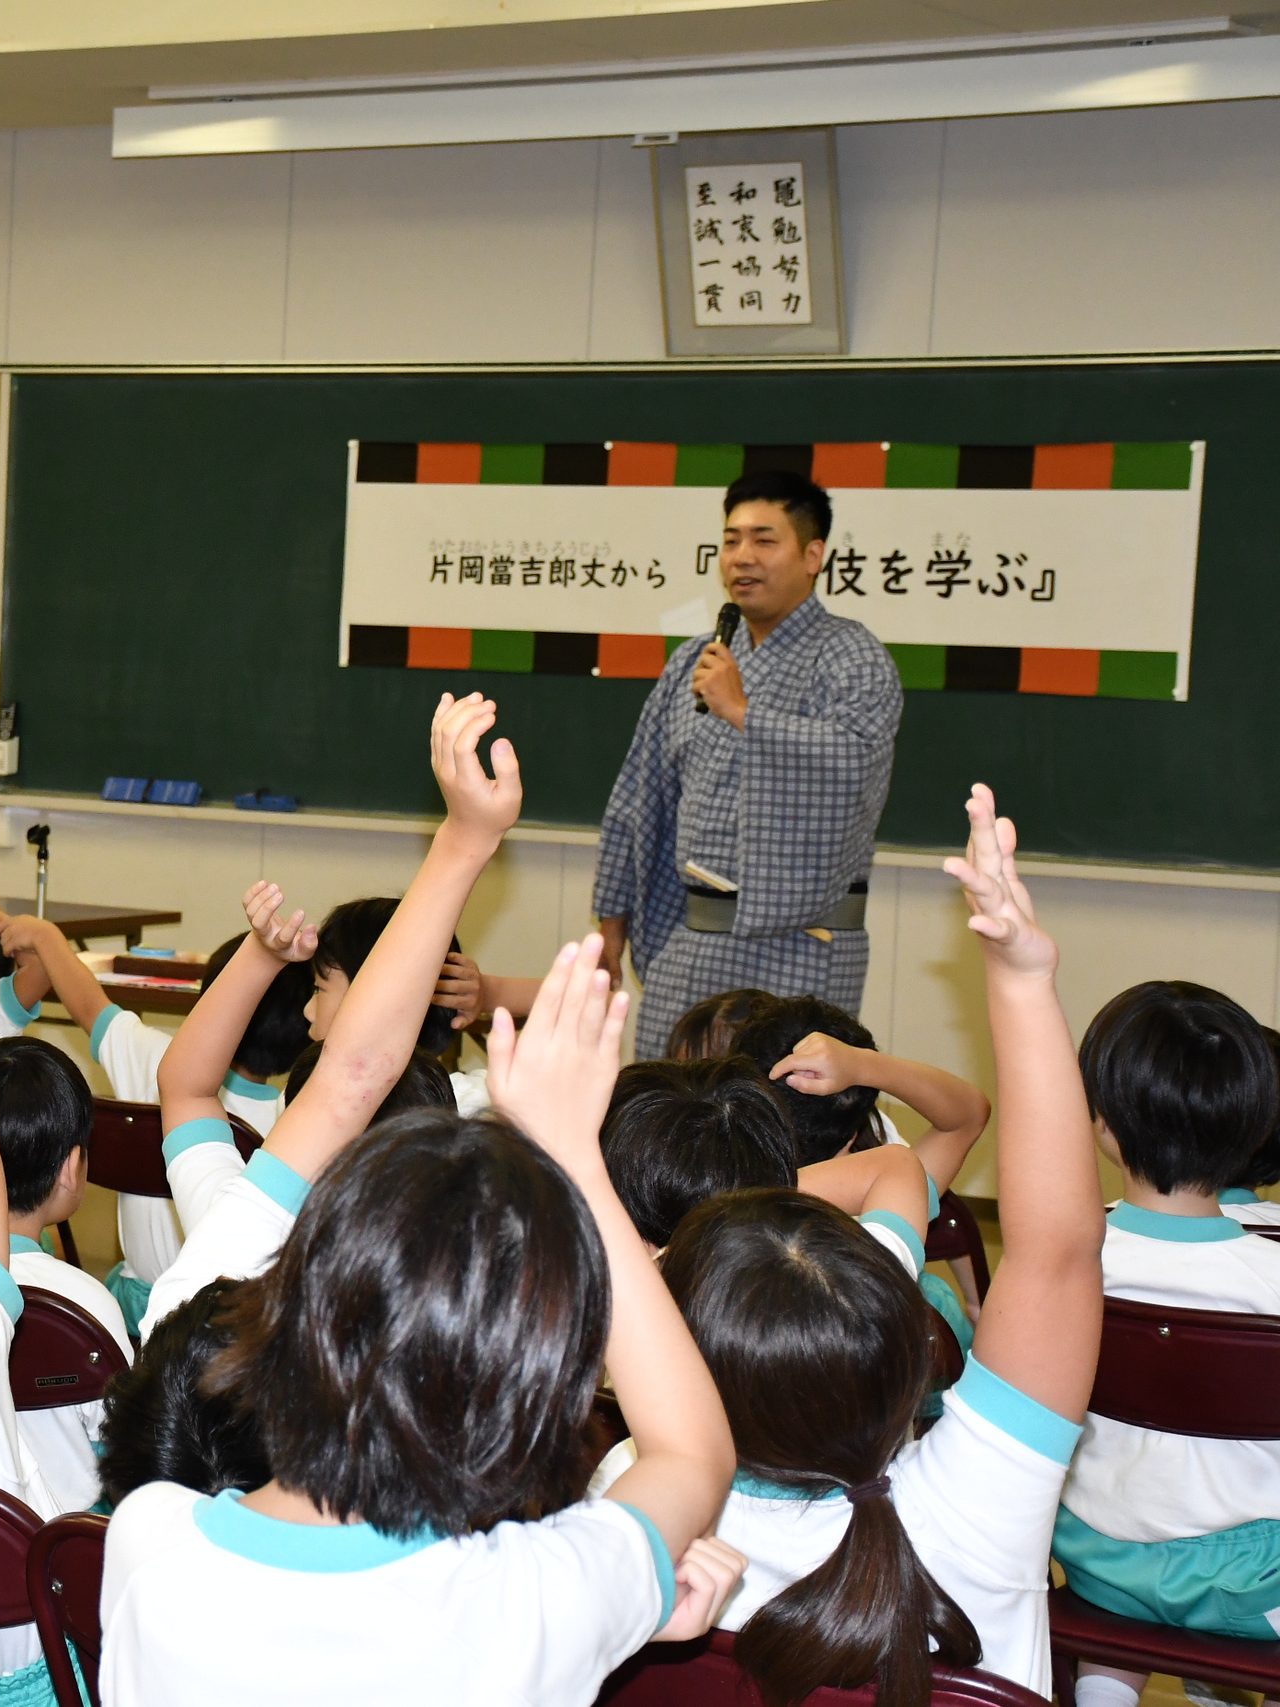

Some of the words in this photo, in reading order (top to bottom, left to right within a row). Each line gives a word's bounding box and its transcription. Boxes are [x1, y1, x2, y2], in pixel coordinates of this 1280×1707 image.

[693, 182, 724, 312] 至誠一貫
[429, 553, 666, 589] 片岡當吉郎丈から
